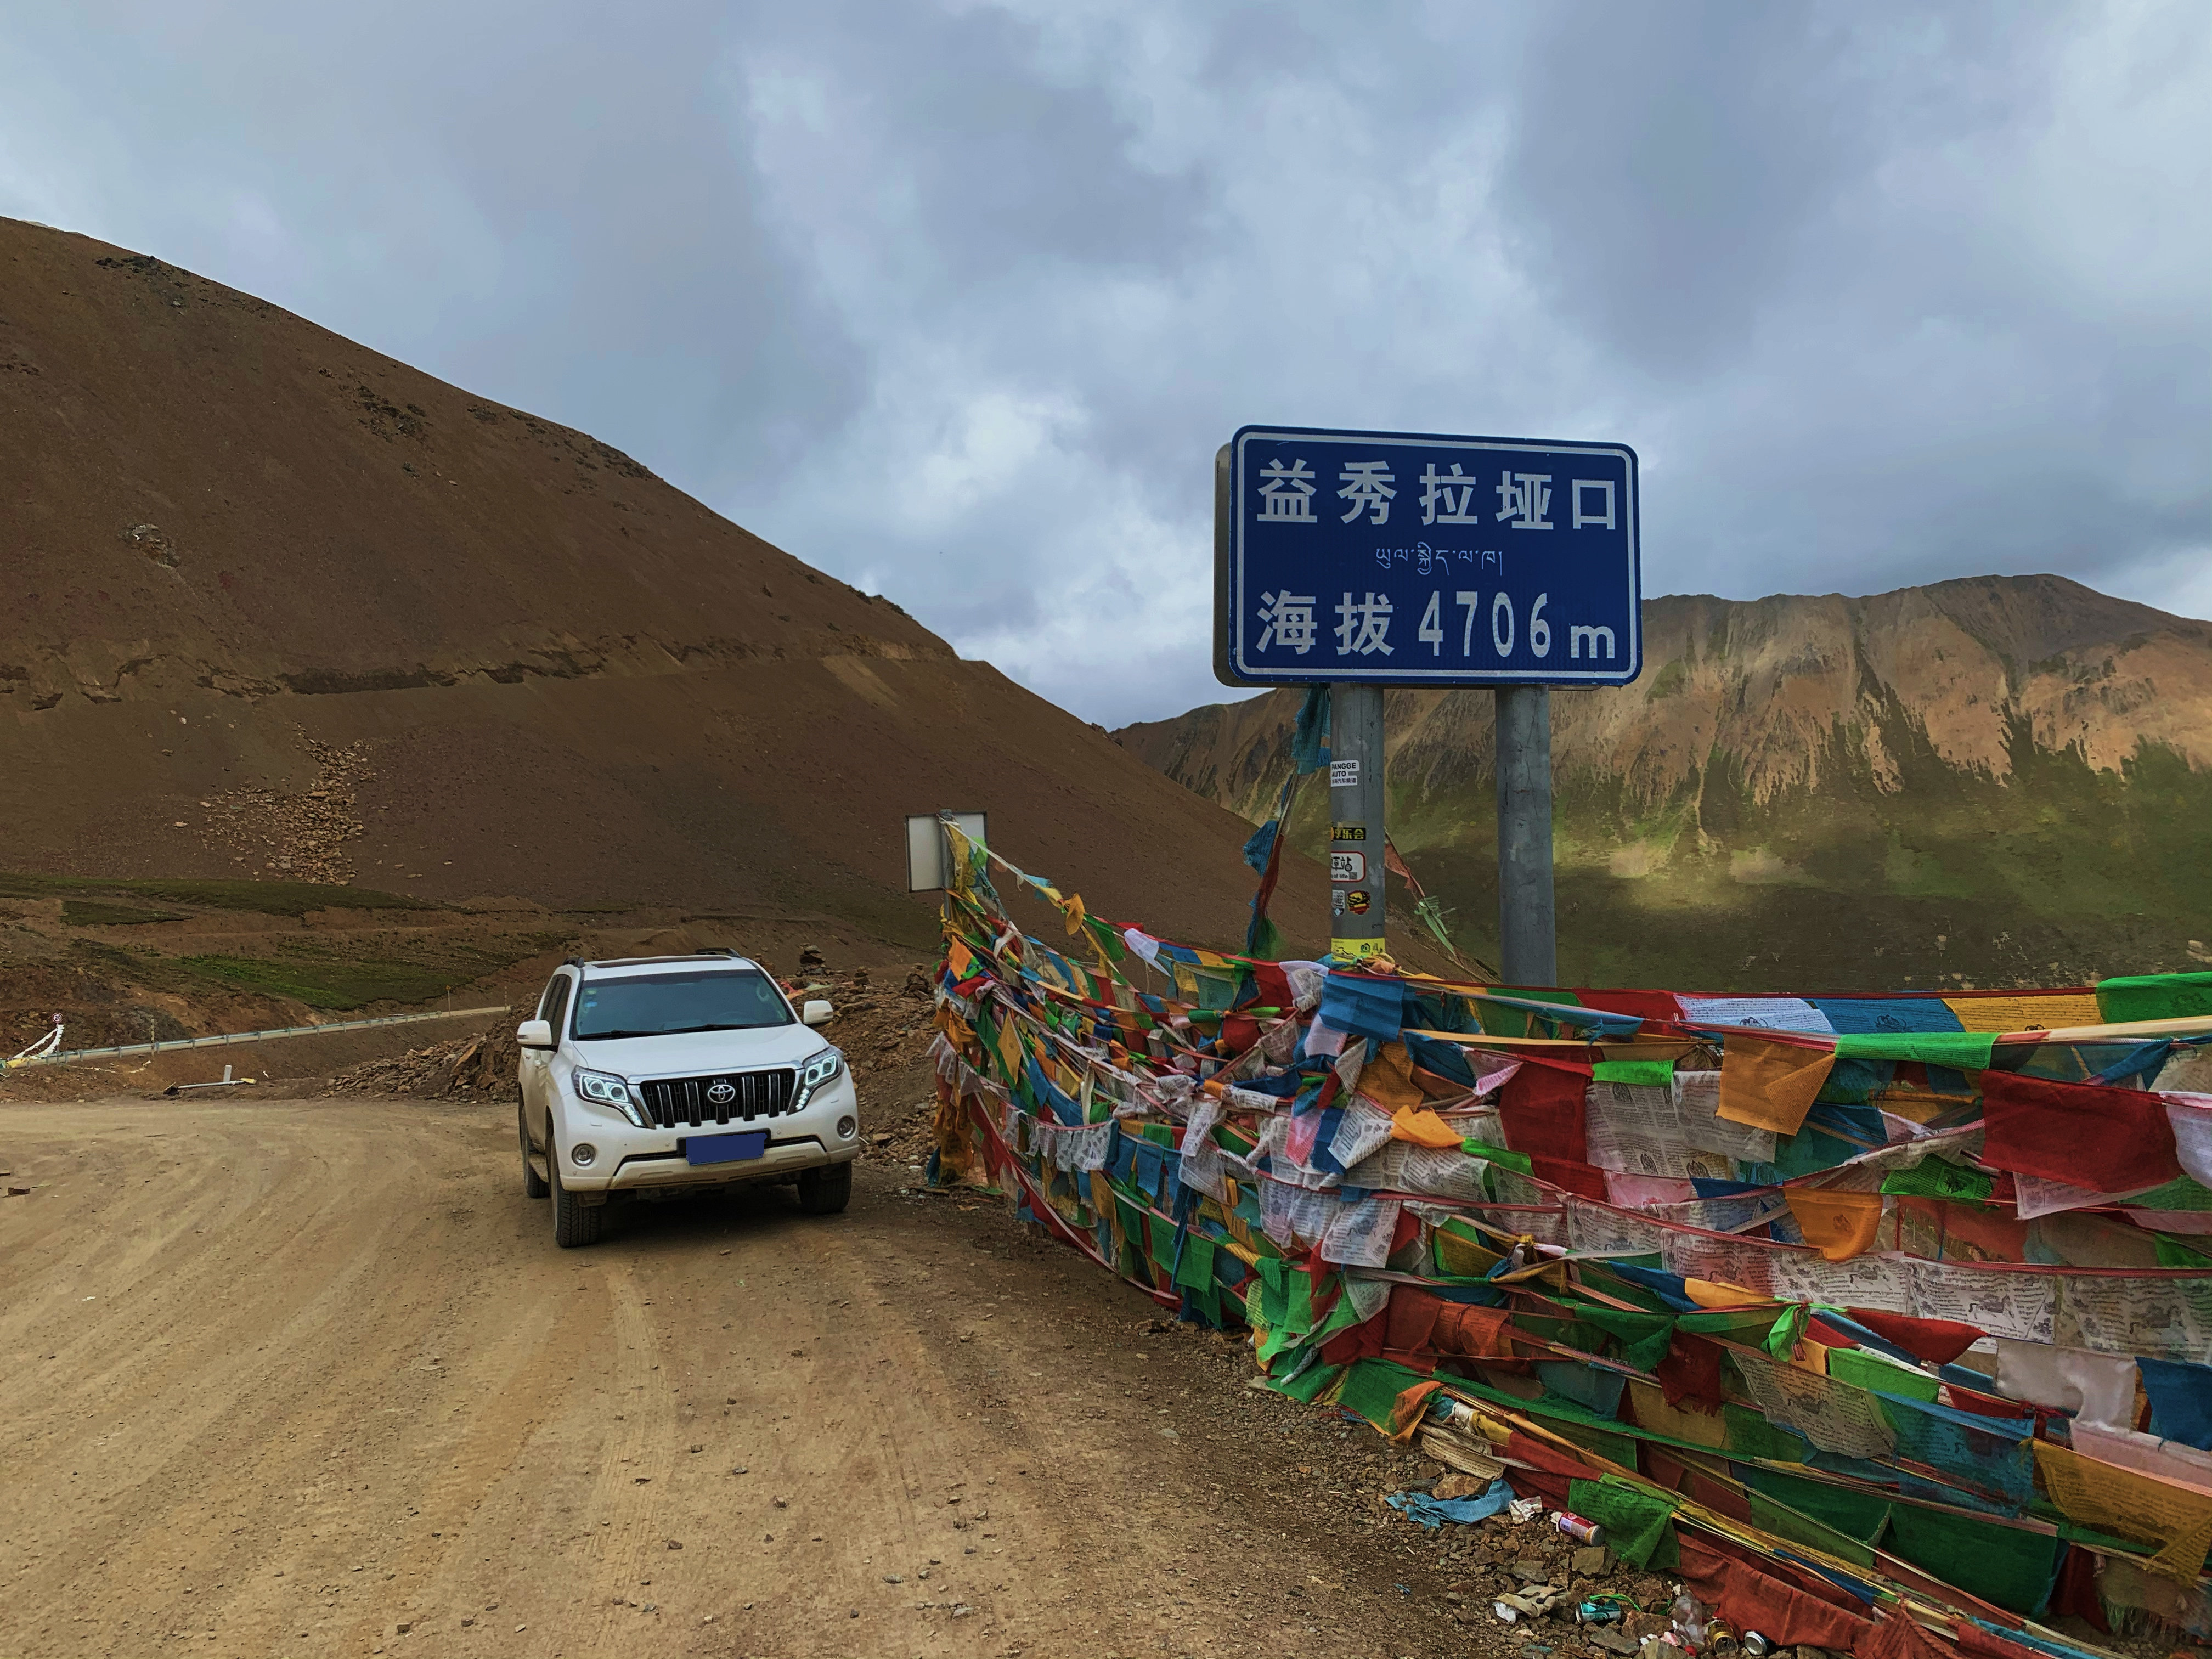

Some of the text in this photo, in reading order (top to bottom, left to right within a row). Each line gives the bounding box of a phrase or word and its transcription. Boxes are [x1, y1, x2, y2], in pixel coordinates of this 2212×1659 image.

[1256, 458, 1616, 531] 益秀拉垭口
[1256, 589, 1615, 659] 海拔 4706 m
[1331, 762, 1356, 770] PANGGE
